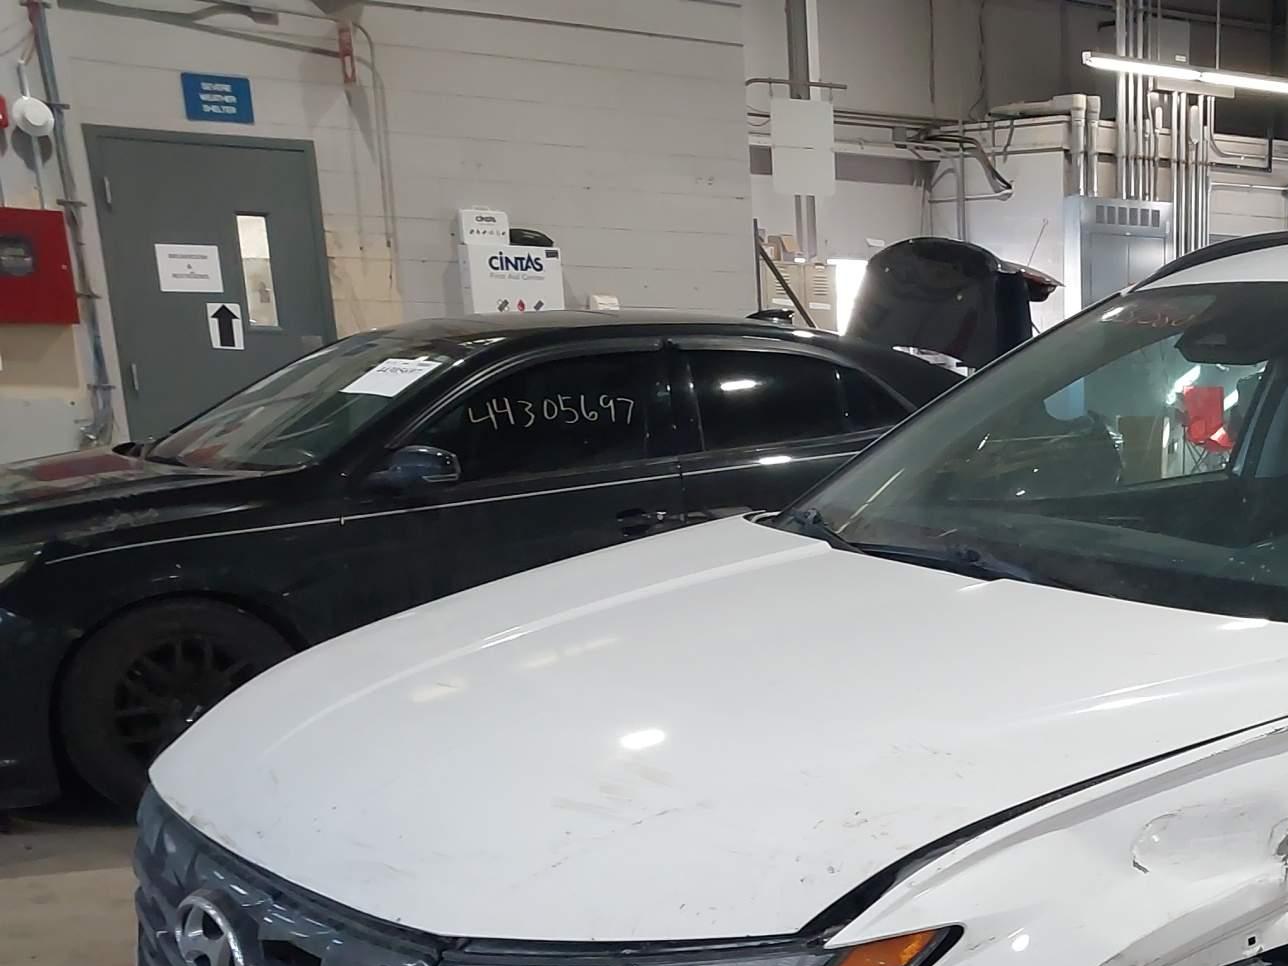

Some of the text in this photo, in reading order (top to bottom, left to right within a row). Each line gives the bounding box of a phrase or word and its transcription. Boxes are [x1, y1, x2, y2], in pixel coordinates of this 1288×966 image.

[200, 82, 232, 92] SEVERE
[199, 93, 237, 103] WEATHER
[202, 104, 237, 114] SHELTER
[468, 394, 635, 430] 44305697
